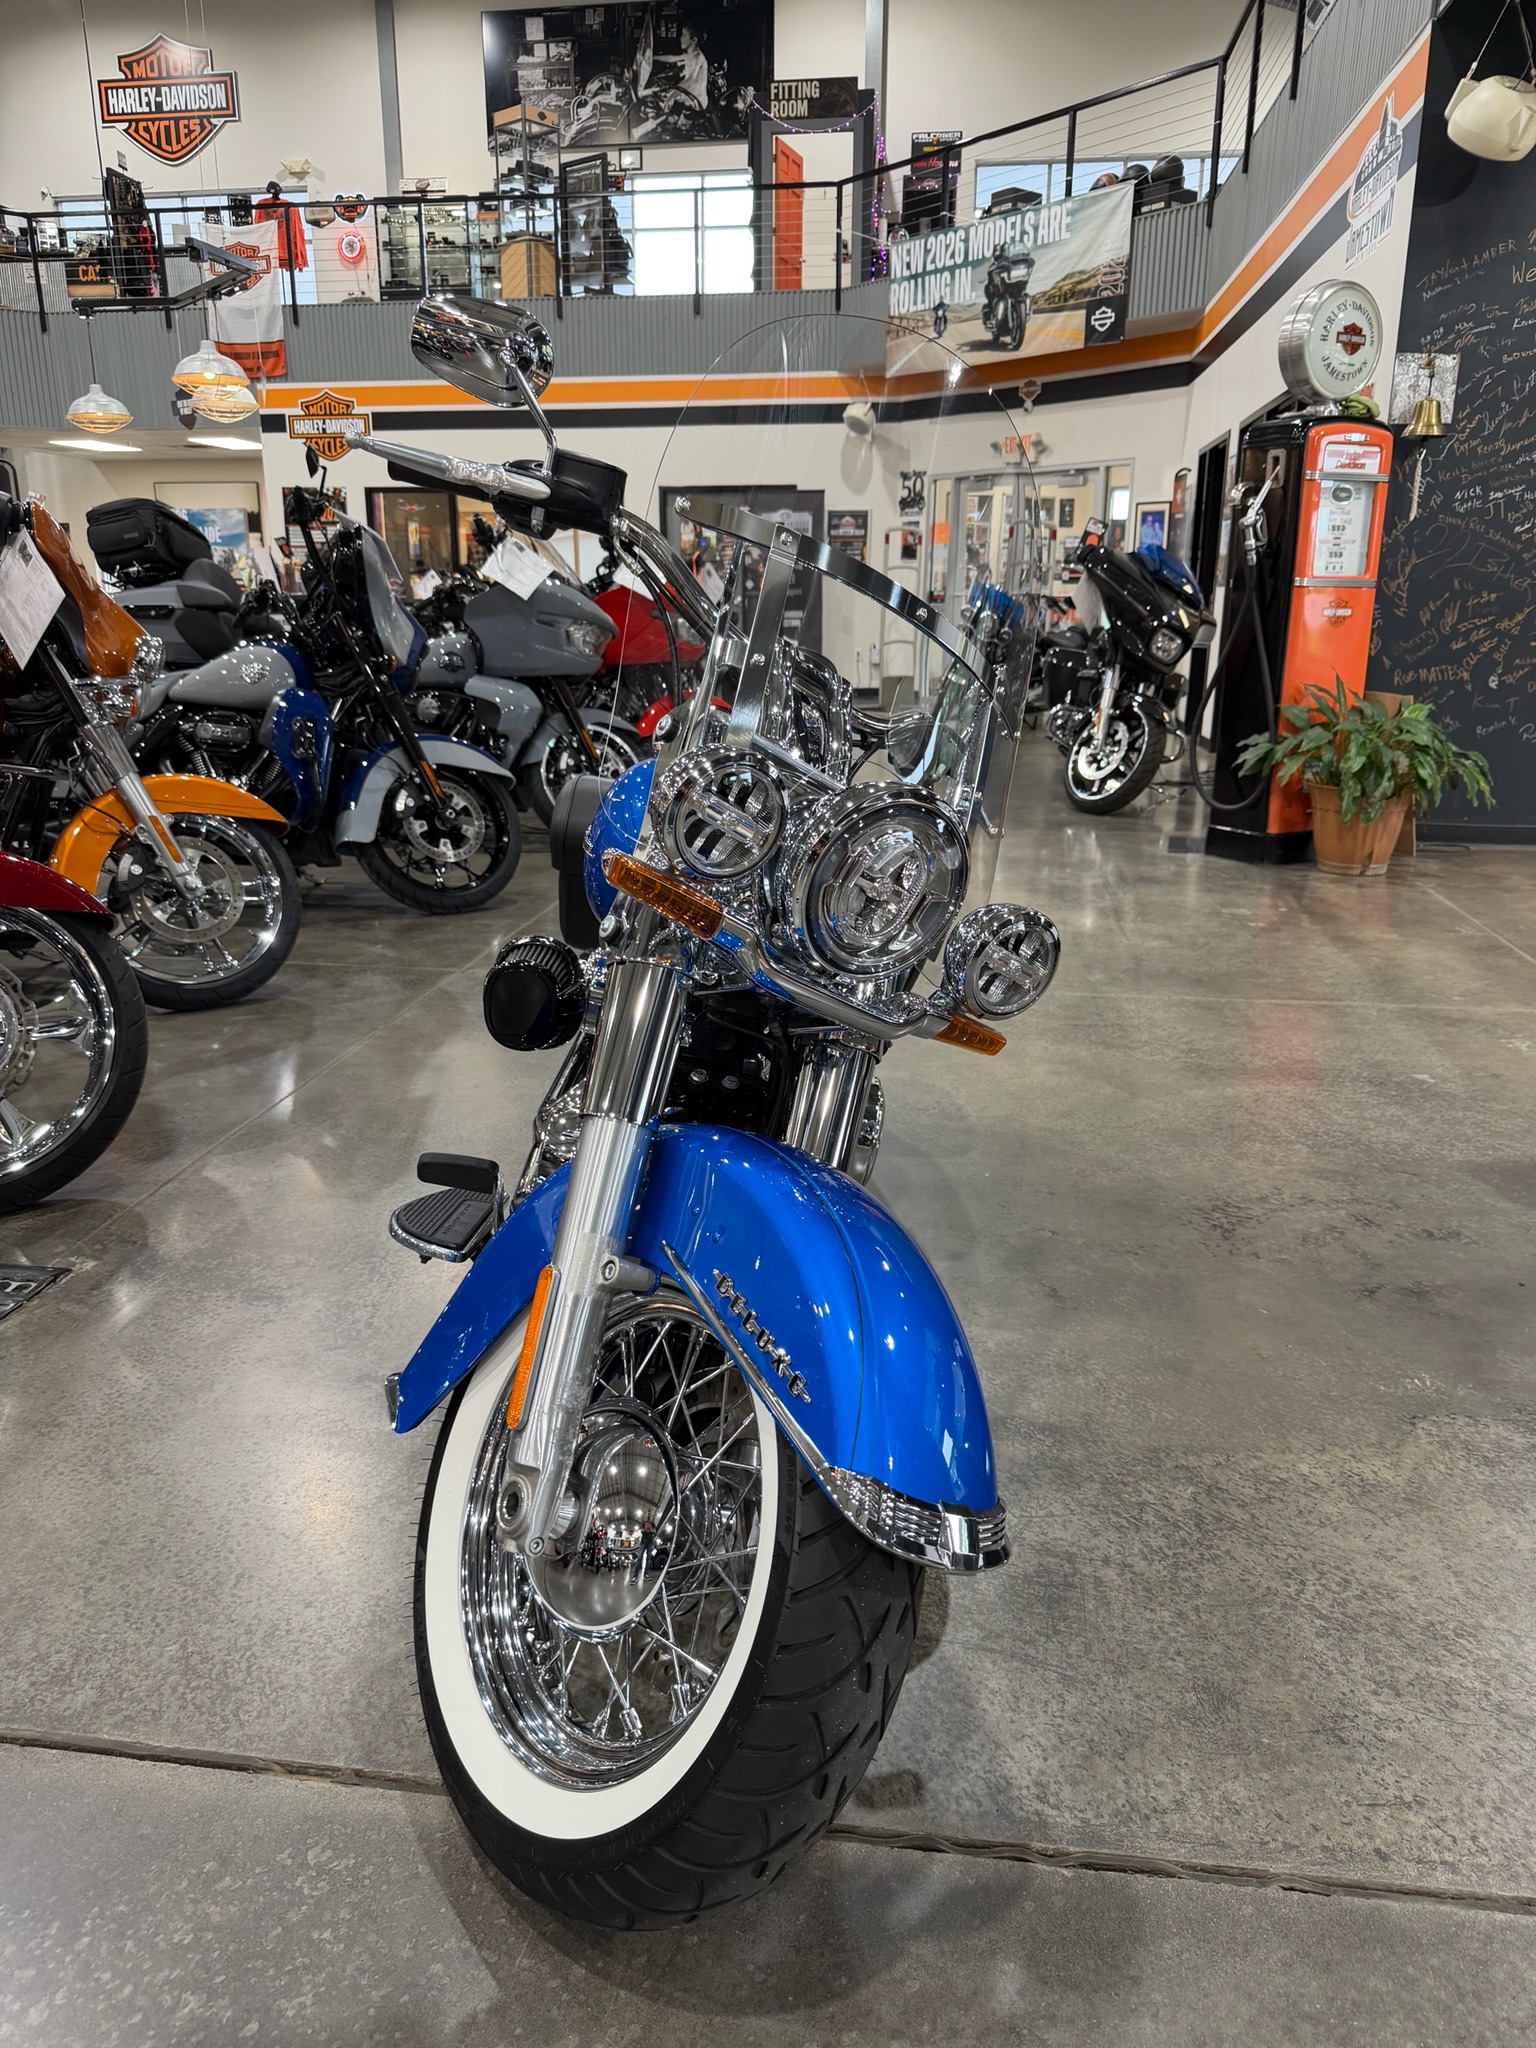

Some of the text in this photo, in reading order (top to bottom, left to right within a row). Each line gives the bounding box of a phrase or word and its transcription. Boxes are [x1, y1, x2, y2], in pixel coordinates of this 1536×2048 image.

[107, 83, 227, 114] HARLEY-DAVIDSON
[770, 80, 820, 99] FITTING
[770, 99, 809, 118] ROOM
[138, 119, 201, 152] CYCLES
[891, 202, 1073, 280] NEW 2026 MODELS ARE
[1472, 239, 1519, 267] AMBER
[890, 265, 976, 318] ROLLING IN.
[1320, 299, 1375, 348] HARLEY-DAVIDSON
[1321, 354, 1369, 382] JAMESTOWN
[308, 400, 347, 415] MOTOR
[293, 418, 366, 434] HARLEY-DAVIDSON
[312, 437, 348, 457] CYCLES
[1335, 460, 1367, 470] Davidson
[902, 476, 924, 500] 50
[715, 1271, 808, 1398] DELUXE
